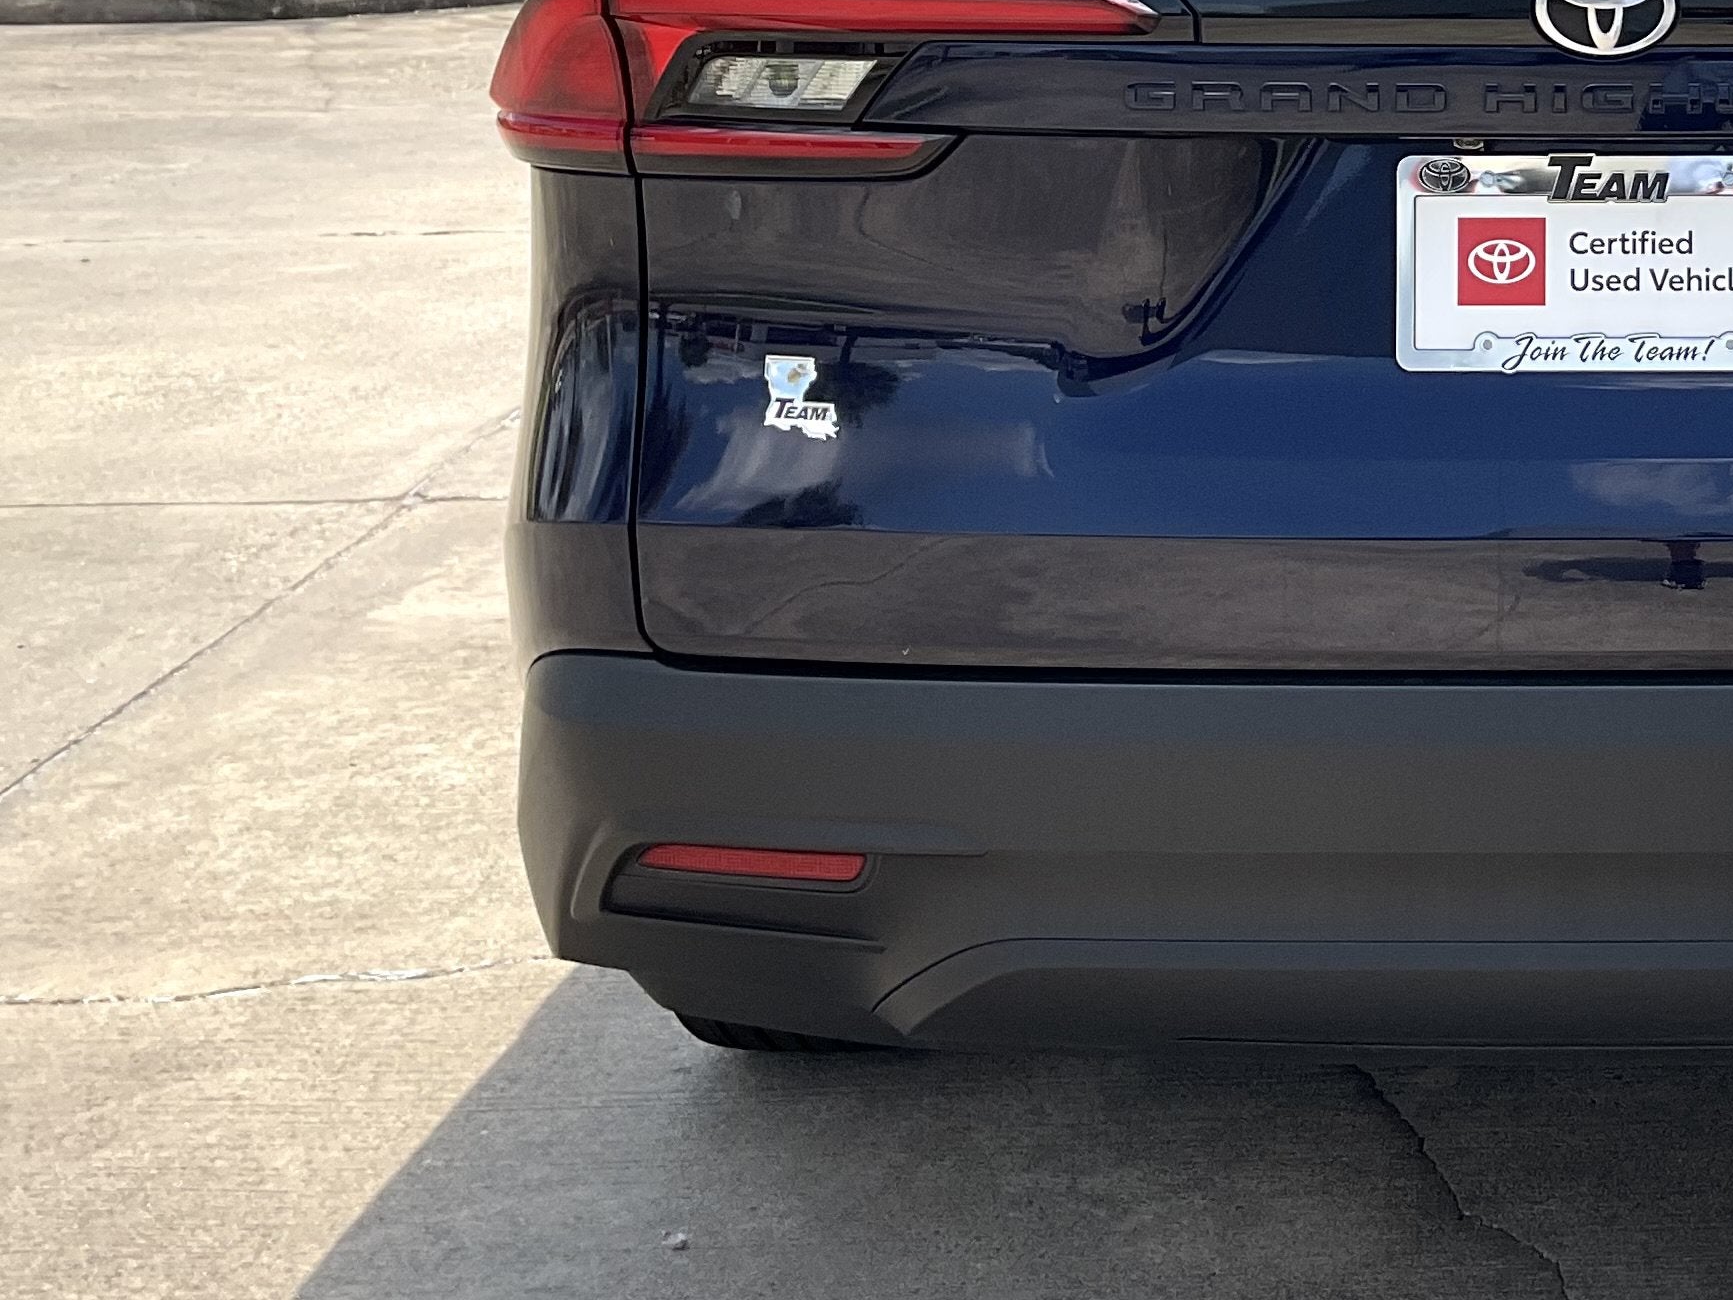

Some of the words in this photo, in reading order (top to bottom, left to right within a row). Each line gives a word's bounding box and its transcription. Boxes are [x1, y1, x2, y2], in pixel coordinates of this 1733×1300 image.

[1124, 81, 1448, 113] GRAND
[1547, 155, 1670, 202] TEAM
[1569, 230, 1694, 255] Certified
[1569, 267, 1641, 292] Used
[1501, 336, 1569, 370] Join
[1572, 336, 1622, 361] The
[1627, 336, 1717, 361] Team!
[774, 397, 829, 420] TEAM
